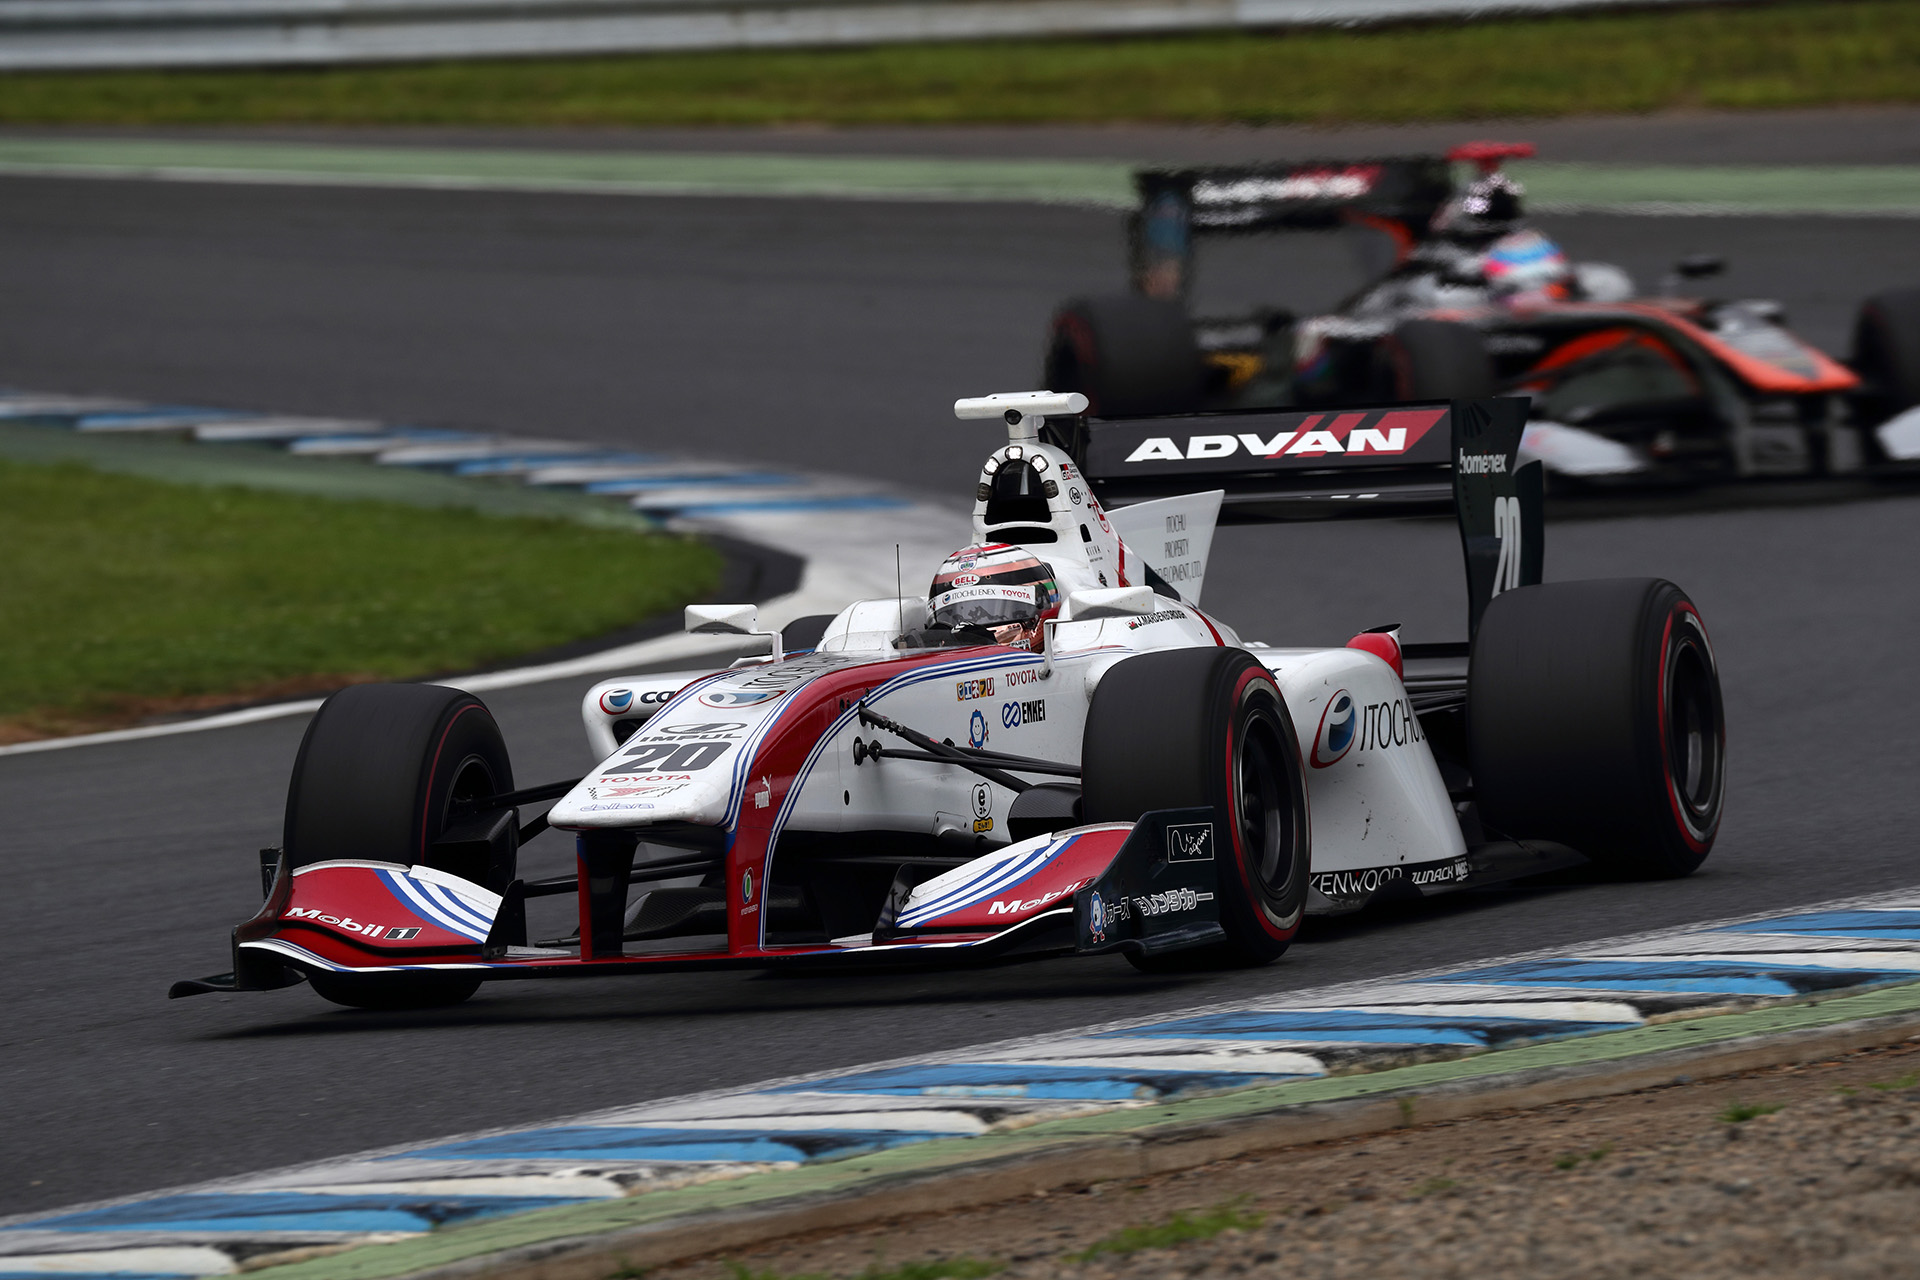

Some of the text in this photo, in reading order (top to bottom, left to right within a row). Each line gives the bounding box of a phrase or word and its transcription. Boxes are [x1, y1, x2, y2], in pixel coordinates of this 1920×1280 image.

[1125, 427, 1407, 462] ADVAN
[1165, 514, 1187, 533] ITOCHU
[1164, 538, 1190, 559] PROPERTY
[1491, 496, 1522, 599] 20
[954, 575, 977, 586] BELL
[951, 588, 1031, 600] ITOCHU ENEX TOYOTA
[1005, 669, 1038, 687] TOYOTA
[1022, 699, 1046, 724] ENKEI
[1359, 698, 1421, 752] ITOCHU
[639, 733, 742, 743] IMPUL
[602, 741, 732, 776] 20
[599, 774, 692, 784] TOYOTA
[987, 881, 1082, 915] Mobil
[286, 907, 385, 938] Mobil
